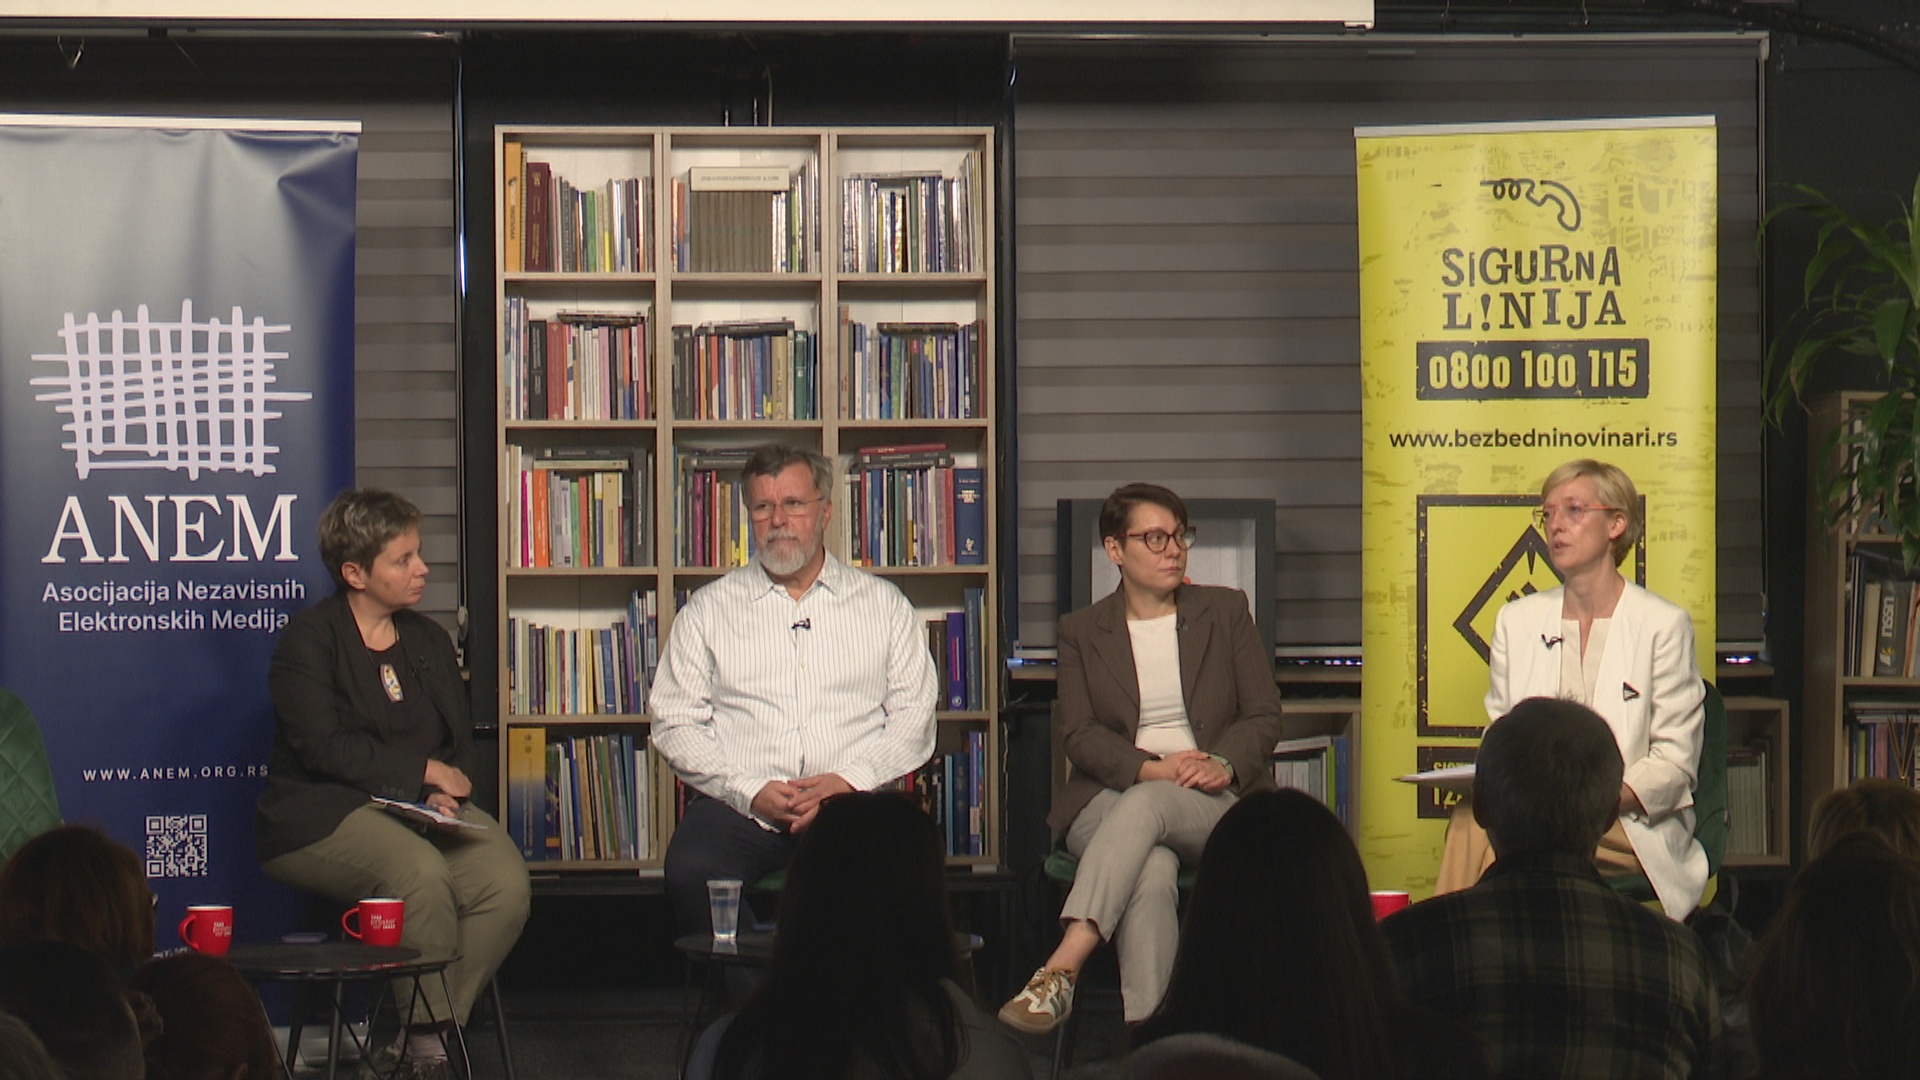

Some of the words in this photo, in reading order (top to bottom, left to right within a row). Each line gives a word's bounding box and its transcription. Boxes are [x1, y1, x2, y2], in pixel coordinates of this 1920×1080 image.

[1442, 244, 1621, 287] SIGURNA
[1428, 349, 1511, 390] 0800
[1521, 349, 1576, 389] 100
[1588, 348, 1637, 388] 115
[1388, 427, 1678, 449] www.bezbedninovinari.rs
[41, 494, 300, 563] ANEM
[41, 581, 170, 605] Asocijacija
[176, 578, 306, 601] Nezavisnih
[59, 610, 205, 632] Elektronskih
[212, 608, 289, 633] Medija
[82, 765, 269, 782] WWW.ANEM.ORG.RS
